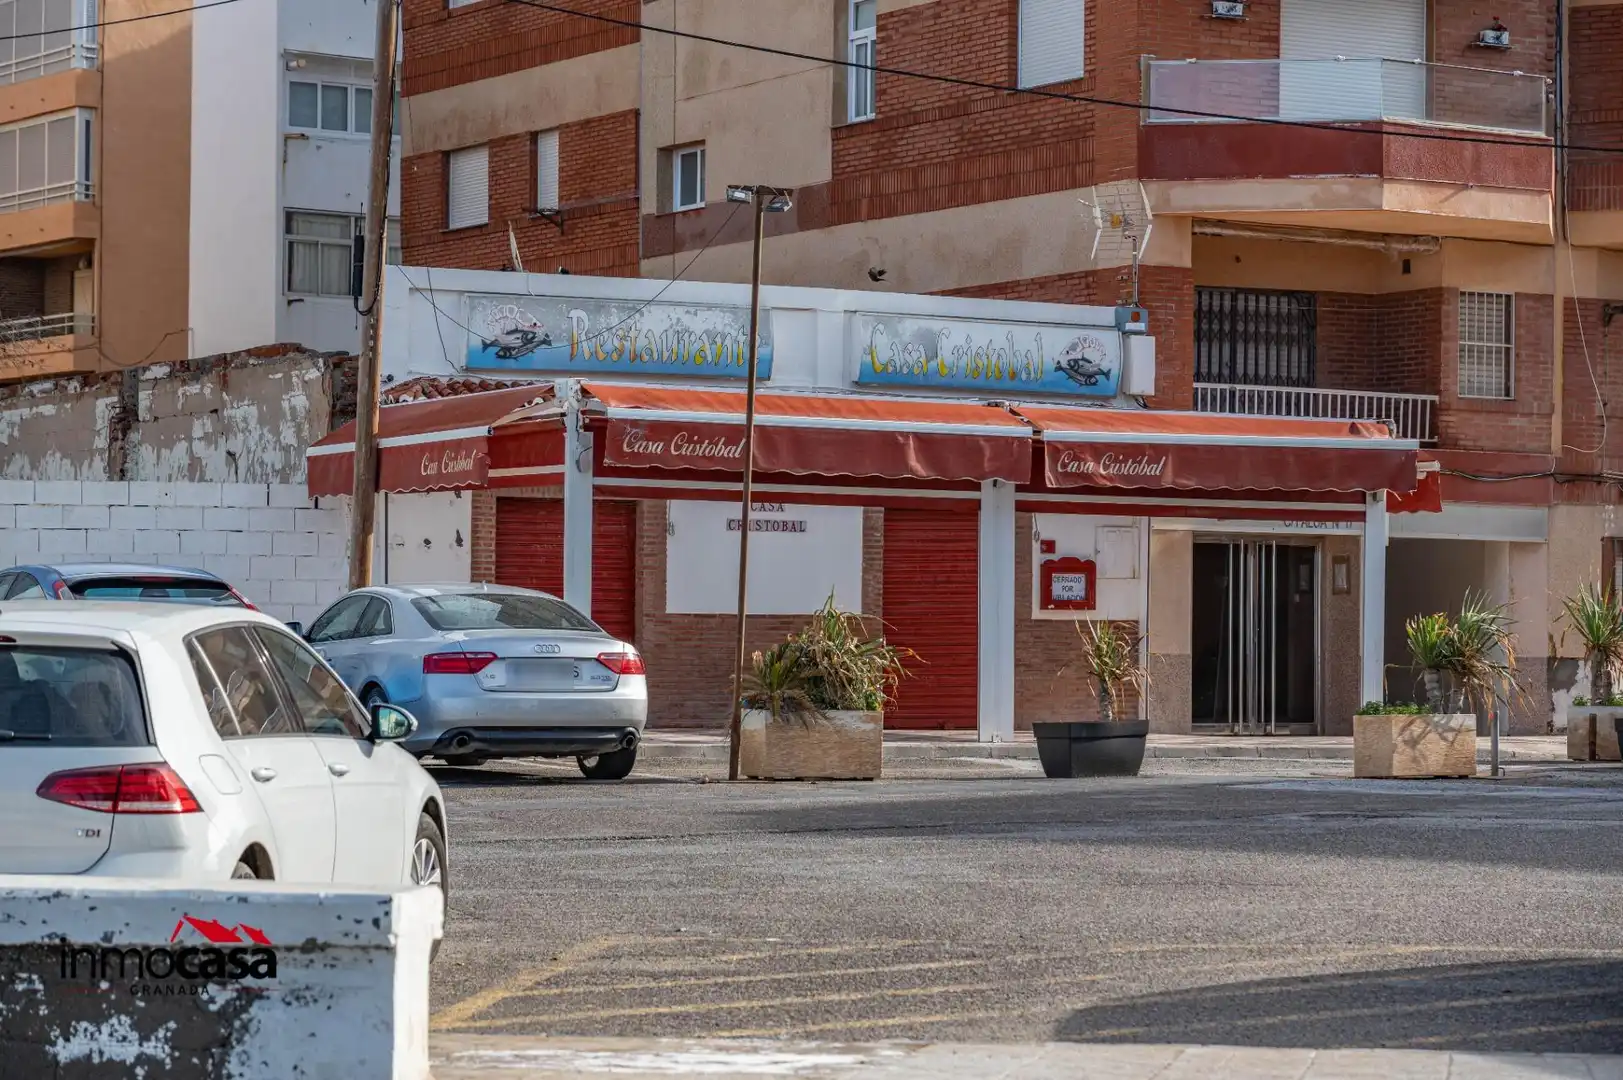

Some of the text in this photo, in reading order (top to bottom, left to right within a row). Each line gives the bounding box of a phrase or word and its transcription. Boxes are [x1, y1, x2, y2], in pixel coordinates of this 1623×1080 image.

[870, 322, 928, 376] Casa
[623, 429, 747, 459] Casa Cristóbal
[1057, 450, 1166, 476] Casa Cristóbal
[77, 828, 101, 838] TDI
